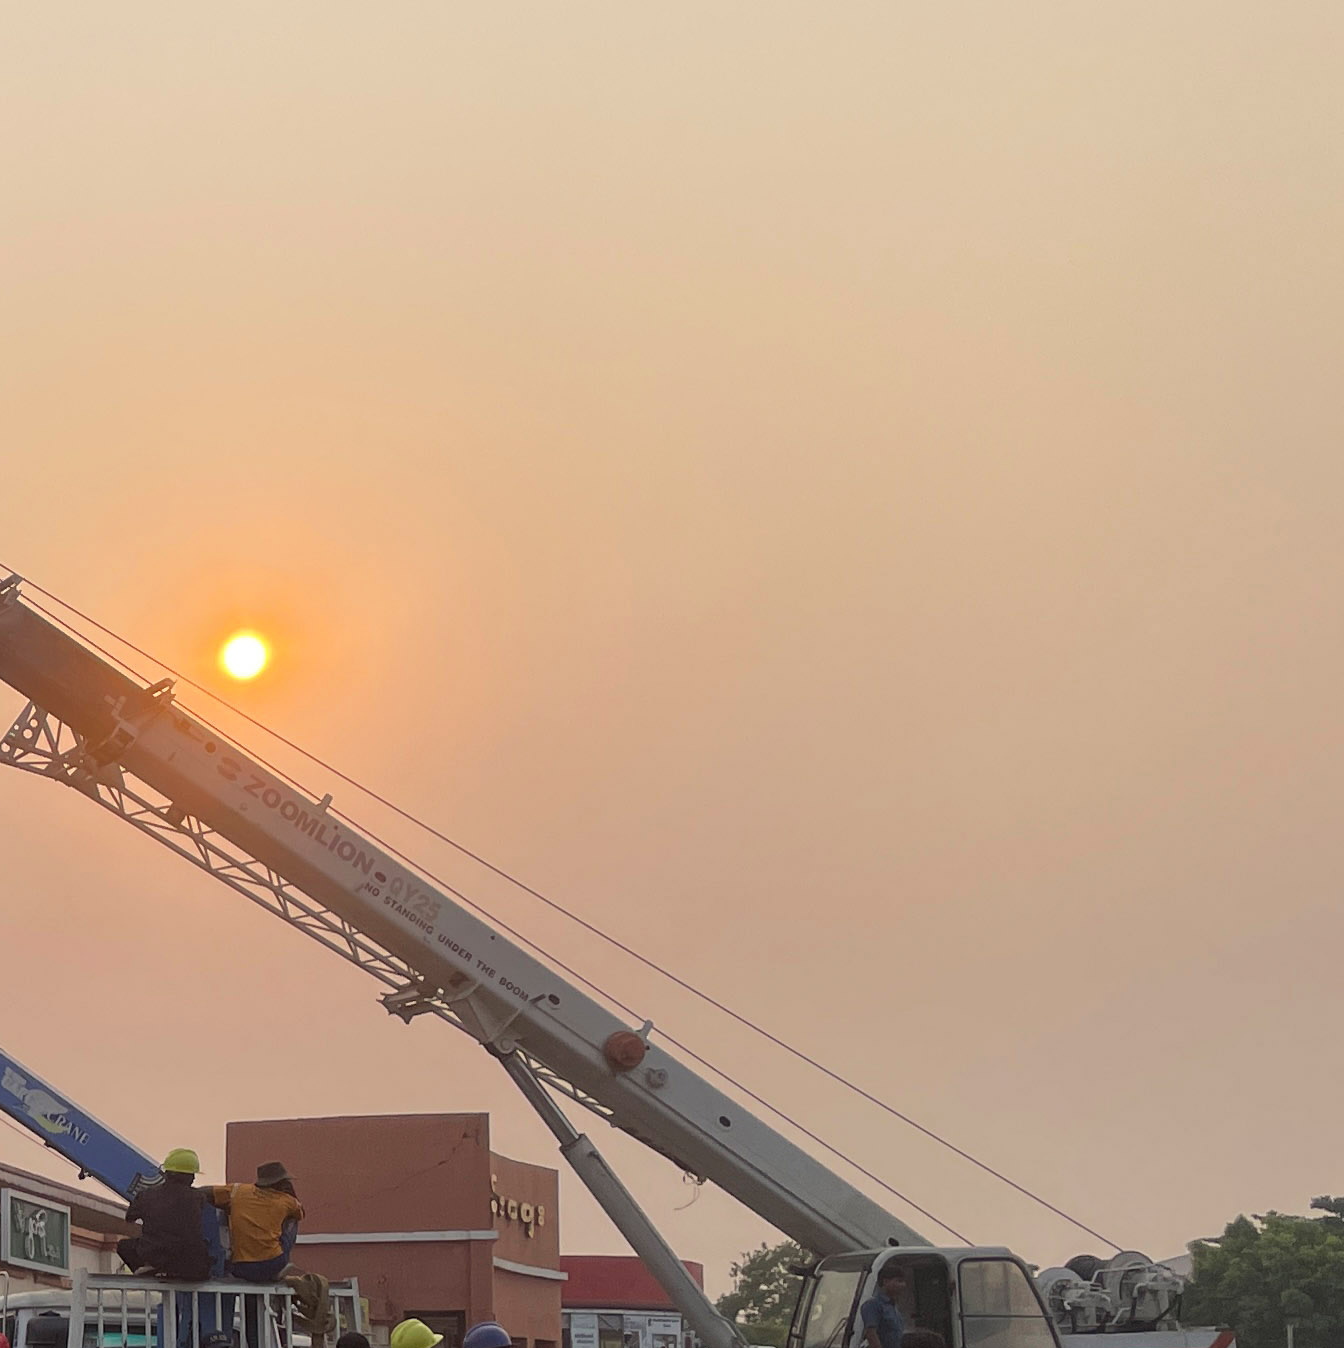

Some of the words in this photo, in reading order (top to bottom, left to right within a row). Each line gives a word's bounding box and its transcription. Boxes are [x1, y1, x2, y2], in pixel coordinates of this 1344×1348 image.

[244, 773, 375, 875] ZOOMLION
[364, 882, 380, 897] NO
[383, 894, 434, 935] STANDING
[438, 933, 472, 962] UNDER
[476, 959, 496, 979] THE
[499, 976, 529, 1001] BOOM
[390, 876, 443, 922] QY25
